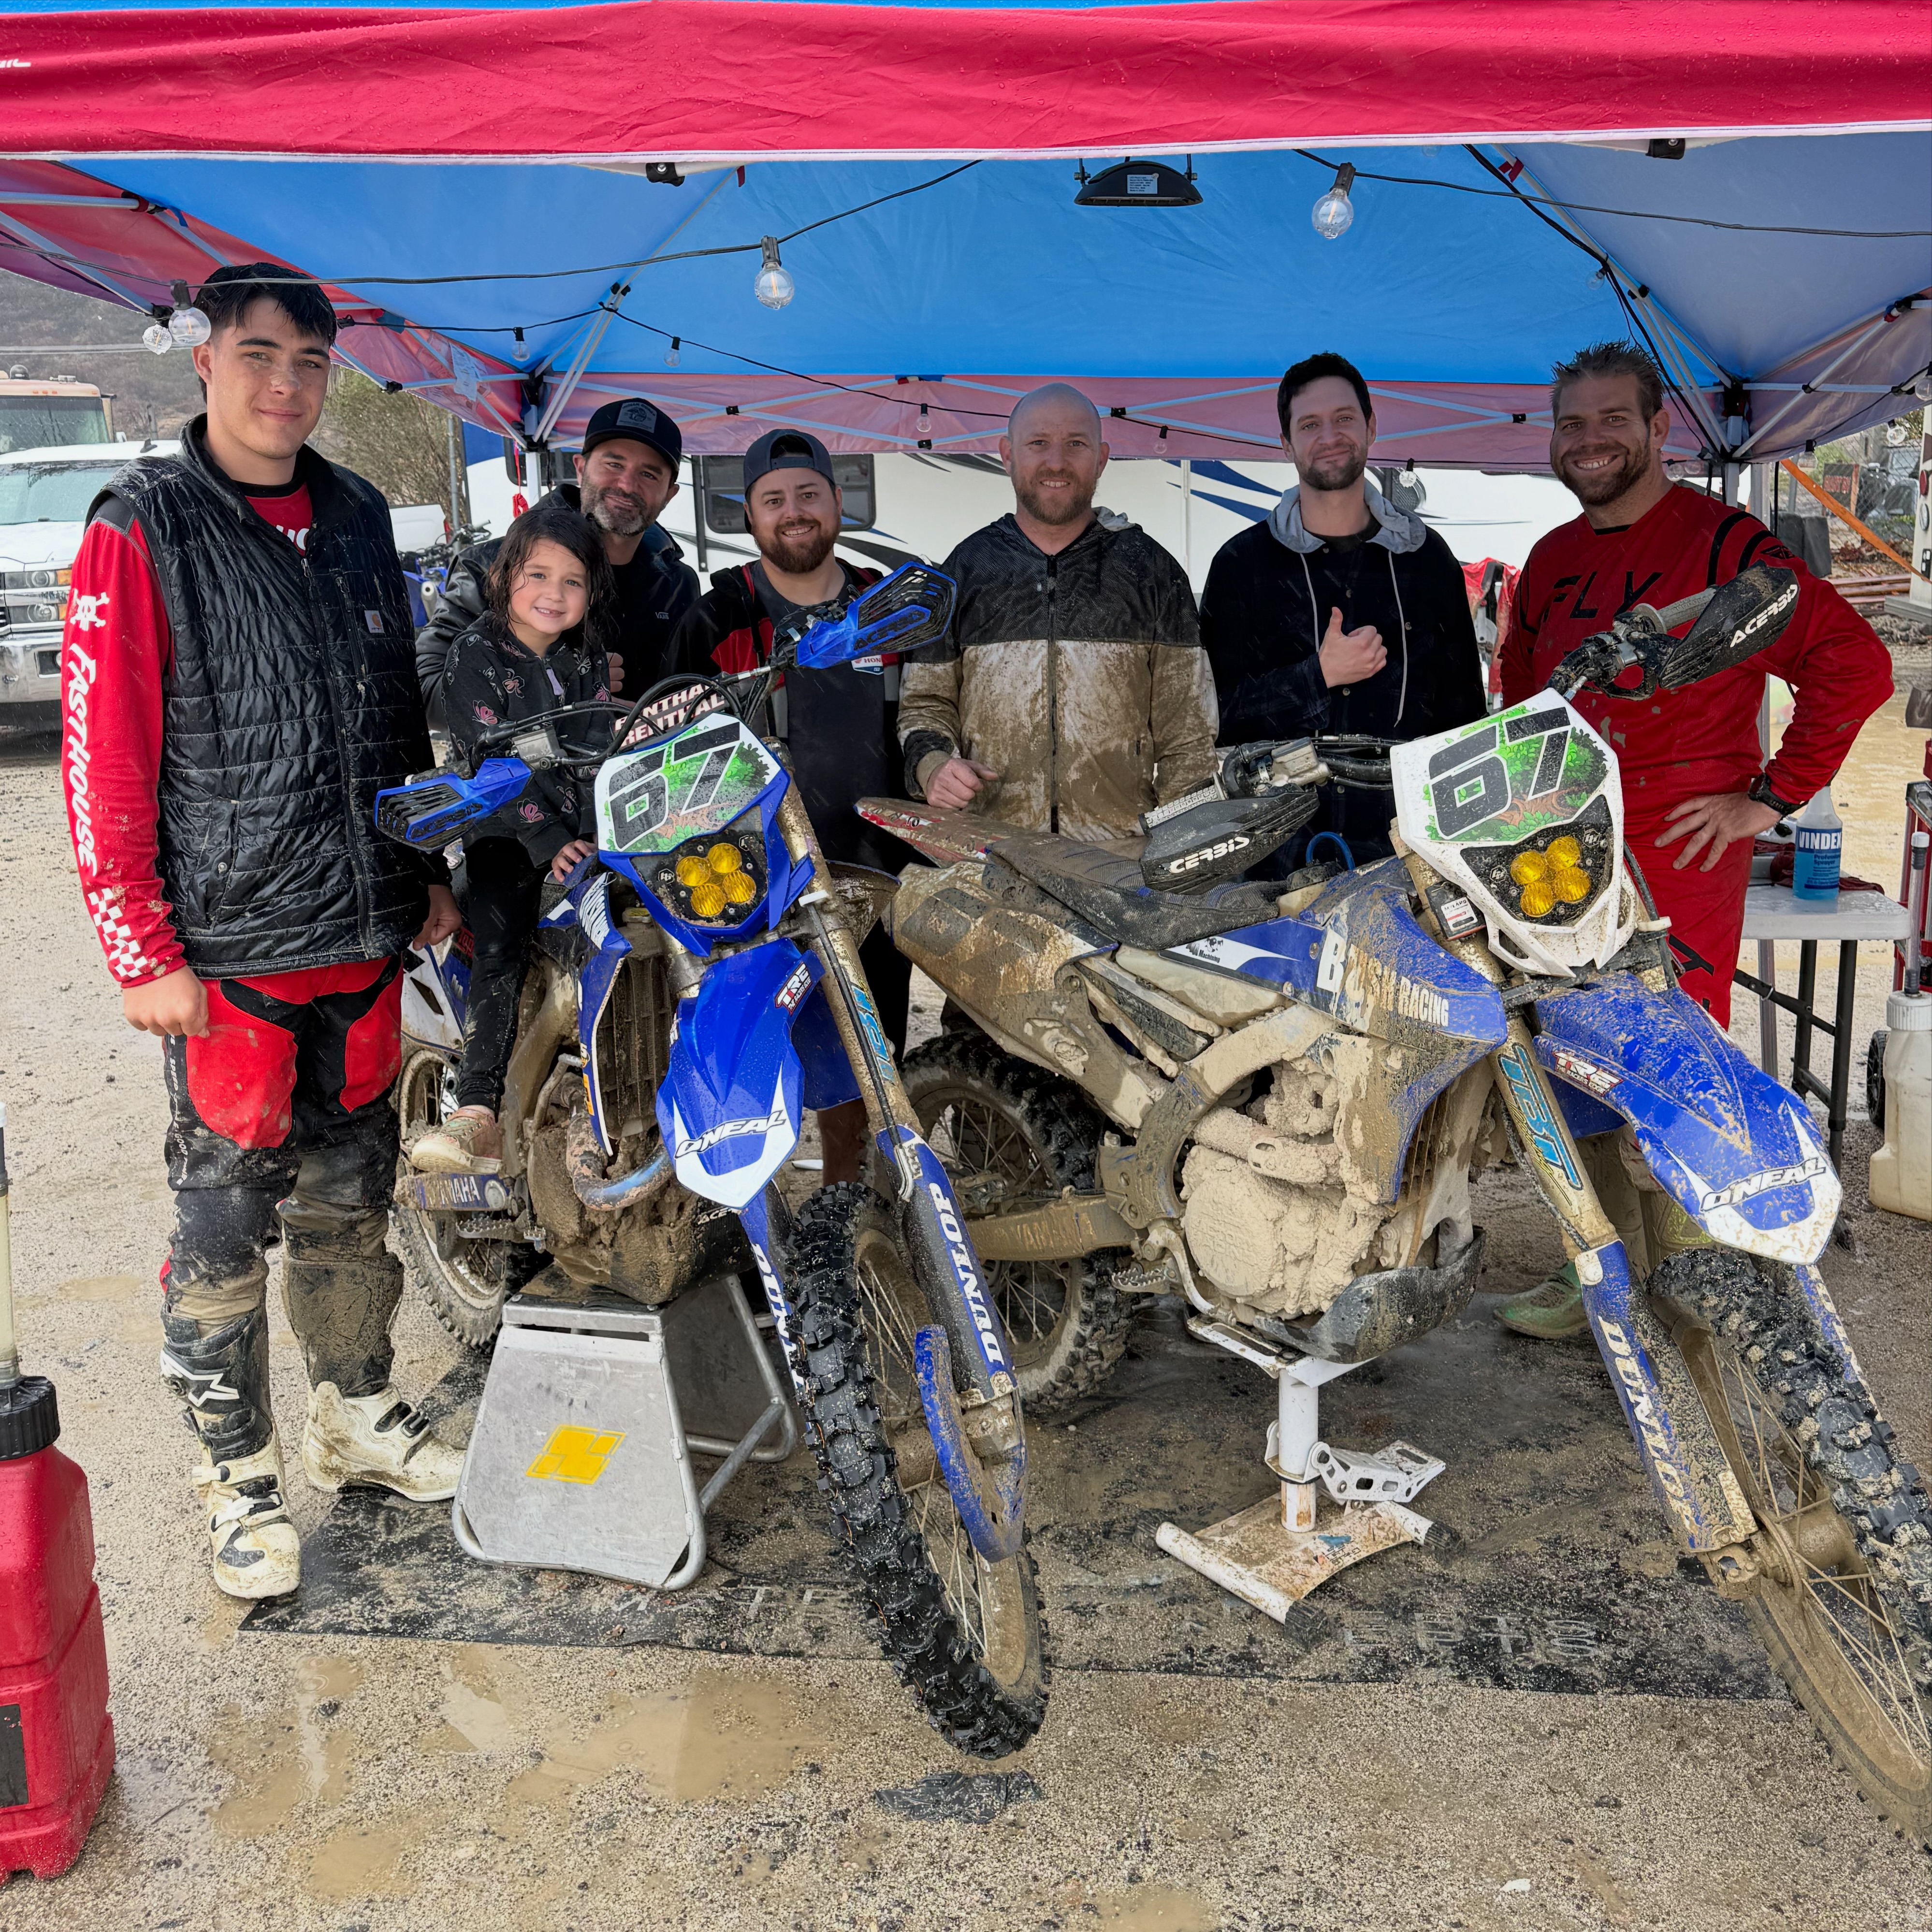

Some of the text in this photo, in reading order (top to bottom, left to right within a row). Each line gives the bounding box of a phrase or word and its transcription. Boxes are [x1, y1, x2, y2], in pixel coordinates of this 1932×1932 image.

[1542, 571, 1663, 623] FLY
[1730, 584, 1798, 648] ACERBIS
[615, 683, 710, 731] RNTHA
[66, 643, 97, 877] FASTHOUSE
[609, 721, 741, 852] 67
[1428, 706, 1571, 839] 67
[1159, 836, 1249, 873] CERBIS
[777, 963, 809, 1005] TRE
[1398, 976, 1449, 1027] RACING
[1554, 1052, 1620, 1089] TRE
[929, 1182, 1004, 1365] DUNLOP
[747, 1243, 805, 1389] DUNL
[1598, 1315, 1699, 1534] DUNLOP
